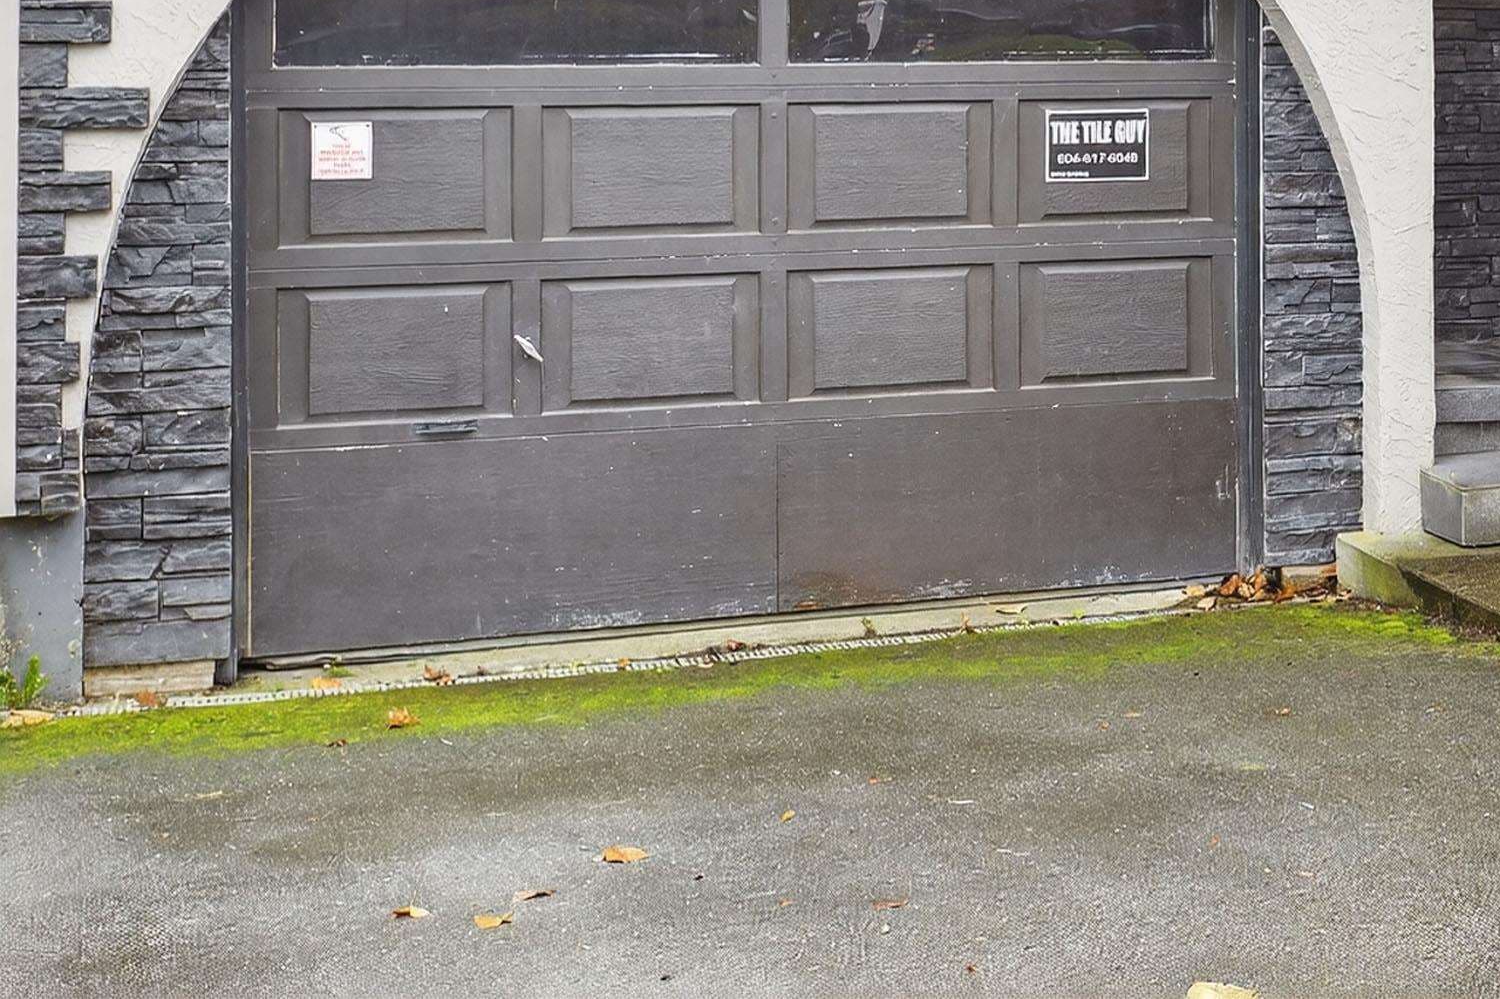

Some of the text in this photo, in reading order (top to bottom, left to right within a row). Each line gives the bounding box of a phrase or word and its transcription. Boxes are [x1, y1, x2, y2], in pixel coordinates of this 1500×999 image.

[1050, 119, 1146, 145] THE TILE GUY
